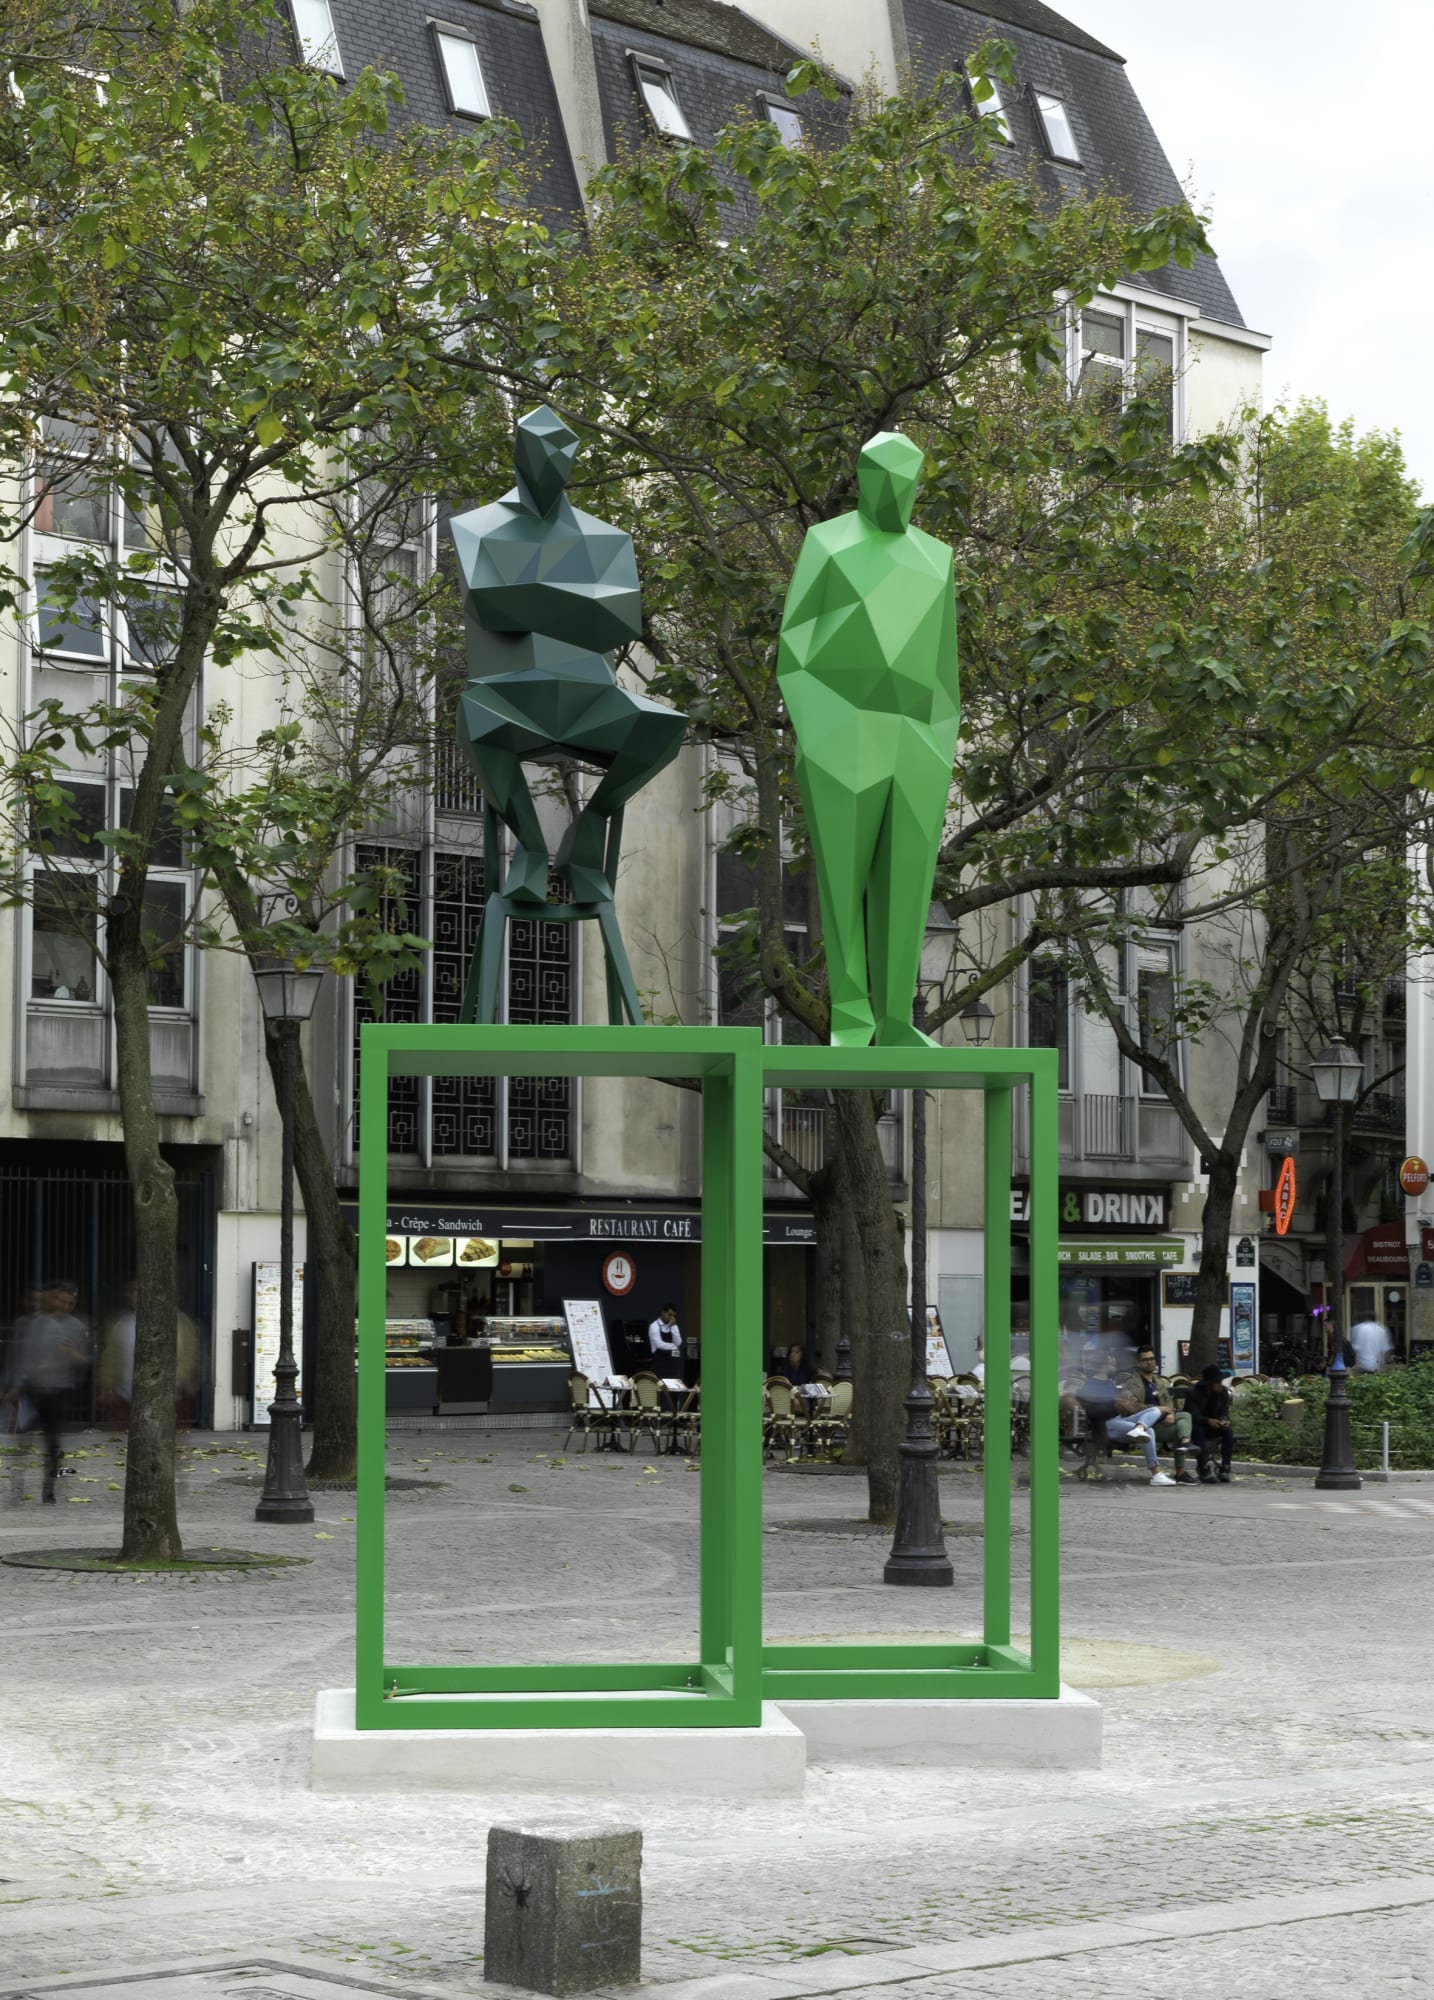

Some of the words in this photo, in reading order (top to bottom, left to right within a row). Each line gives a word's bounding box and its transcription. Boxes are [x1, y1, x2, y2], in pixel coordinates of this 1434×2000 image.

[1280, 1173, 1290, 1219] TABAC
[1063, 1192, 1081, 1223] &
[1087, 1193, 1164, 1225] DRINK
[401, 1216, 429, 1231] Crêpe
[438, 1218, 483, 1231] Sandwich
[589, 1218, 658, 1236] RESTAURANT
[663, 1218, 691, 1237] CAFÉ
[1367, 1255, 1408, 1263] BEAUBOURG
